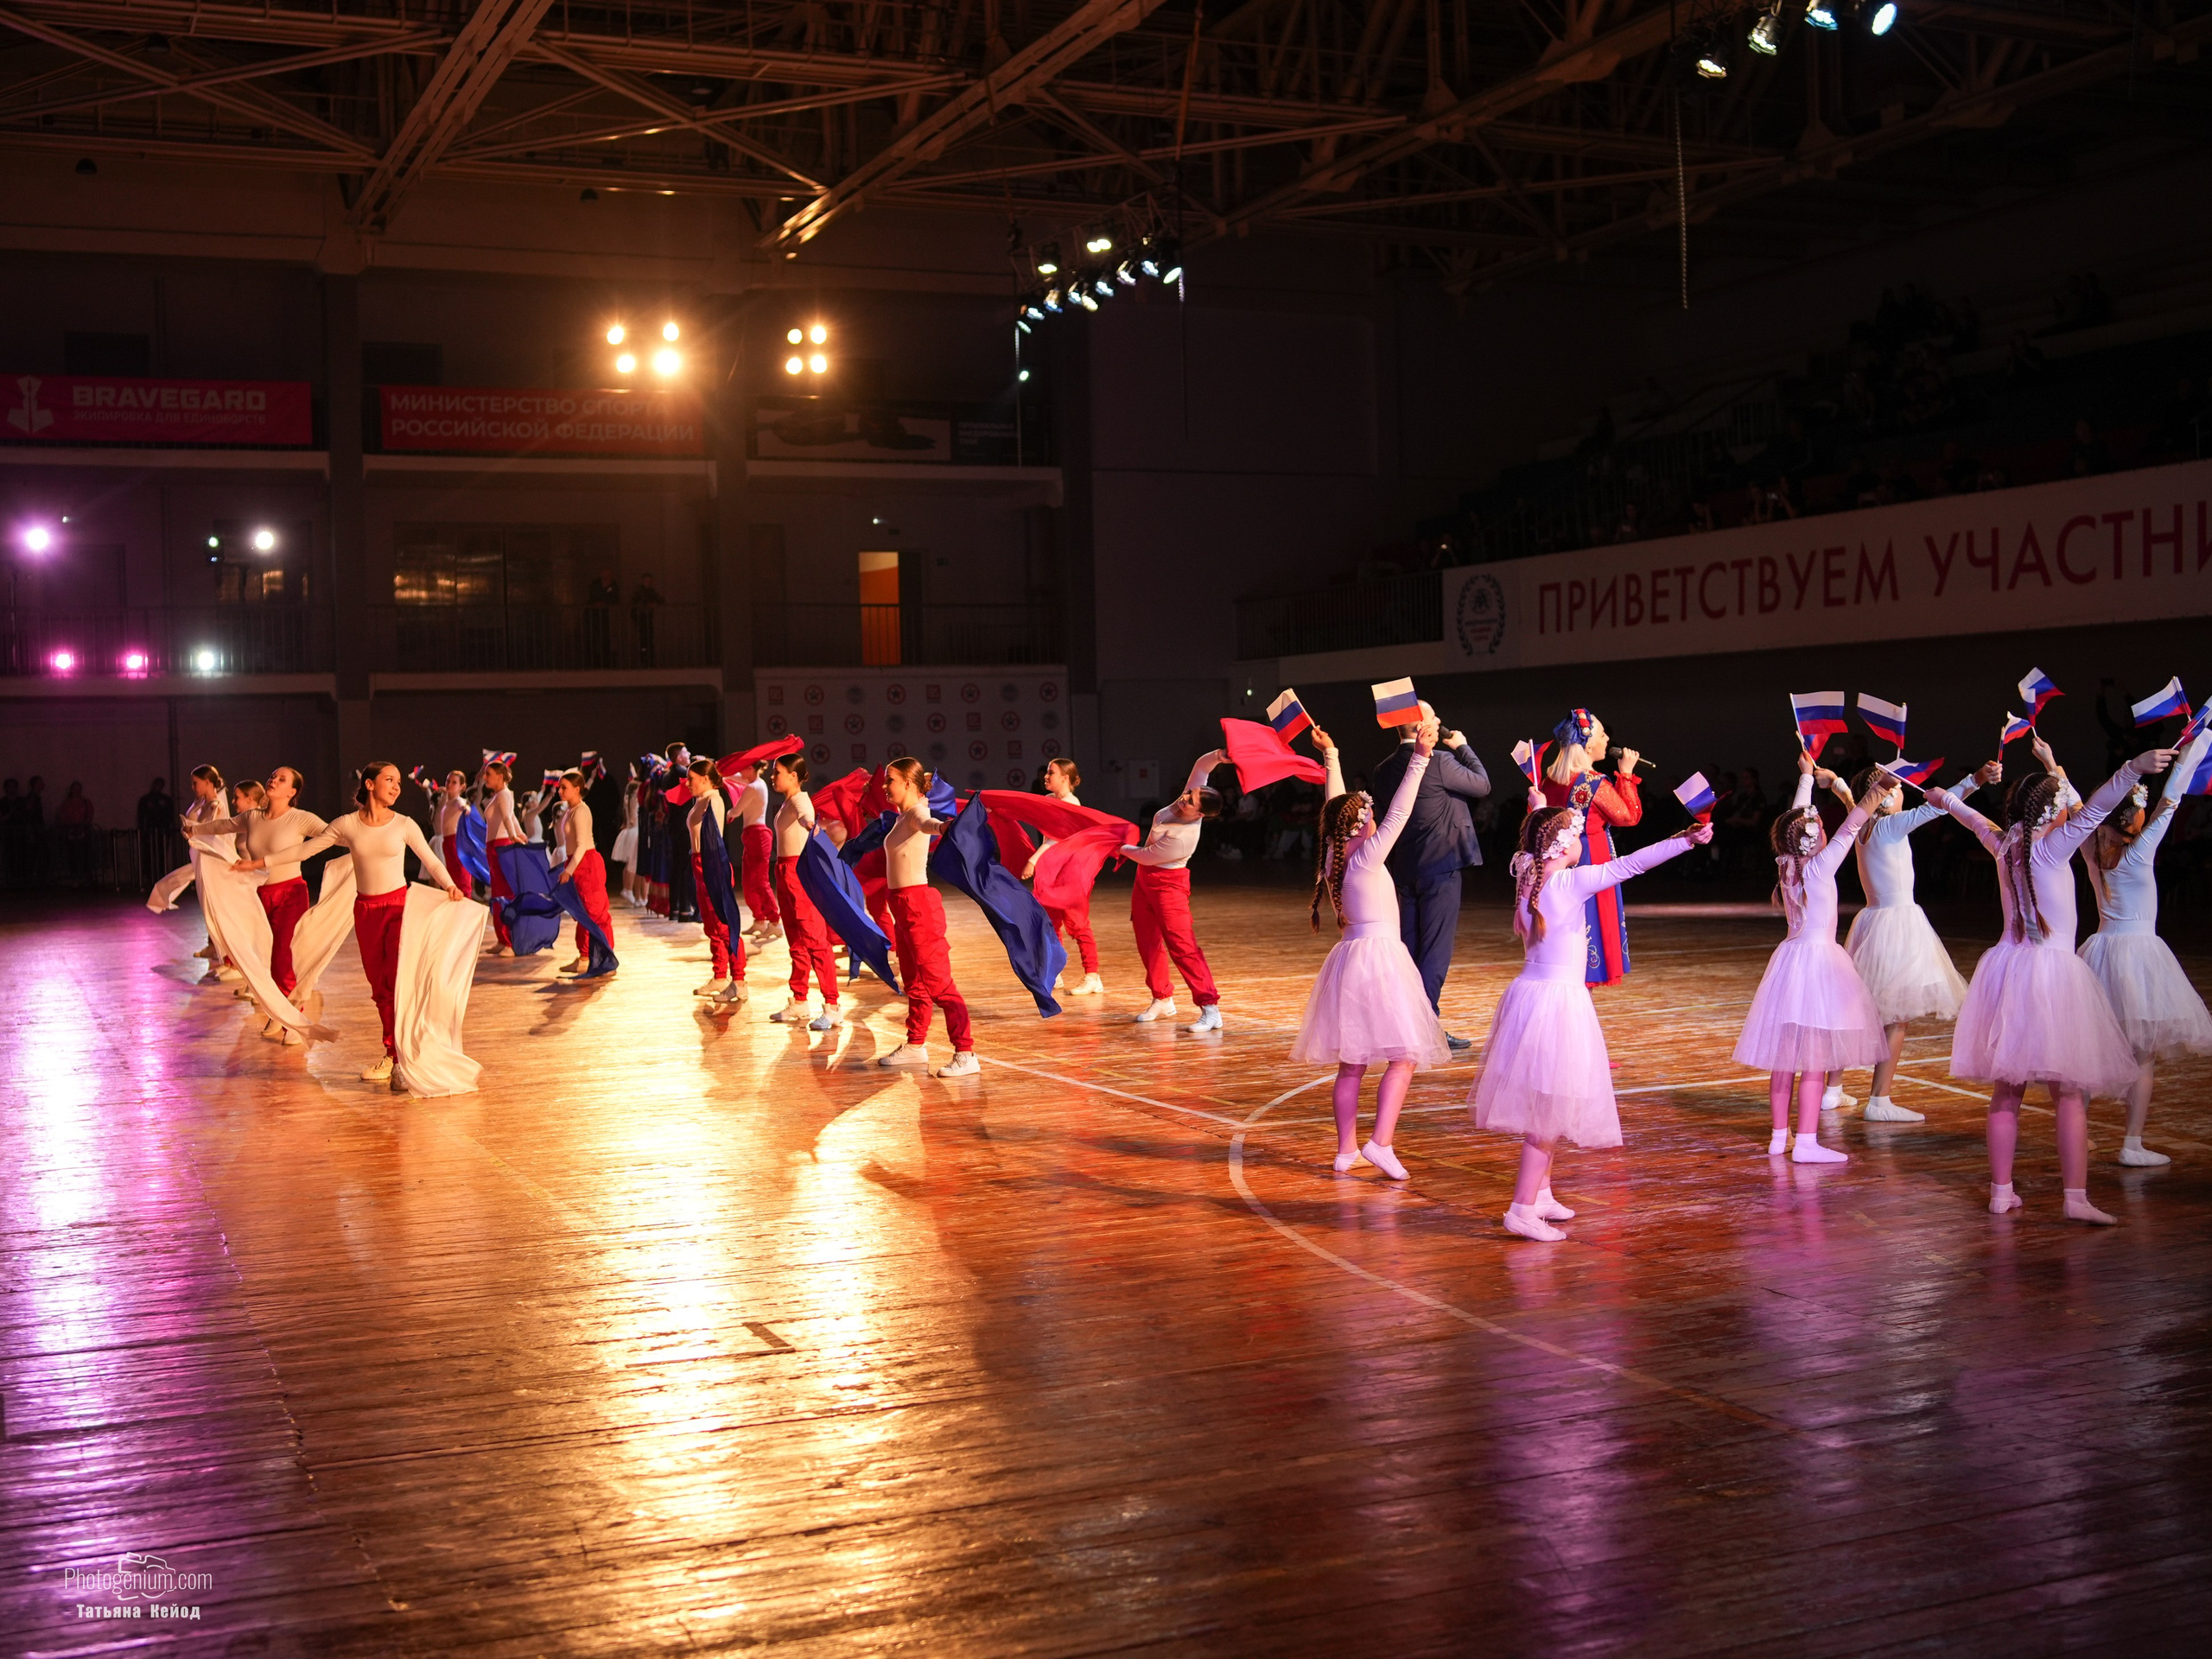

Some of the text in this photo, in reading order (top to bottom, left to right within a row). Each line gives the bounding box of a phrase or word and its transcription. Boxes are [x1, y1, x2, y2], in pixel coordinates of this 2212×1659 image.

[73, 385, 267, 411] BRAVEGARD
[390, 393, 671, 417] МИНИСТЕРСТВО СПОРТА
[73, 410, 153, 423] ЭКИПИРОВКА
[155, 412, 181, 424] ДЛЯ
[391, 416, 694, 445] РОССИЙСКОЙ ФЕДЕРАЦИИ
[1538, 538, 1900, 635] ПРИВЕТСТВУЕМ
